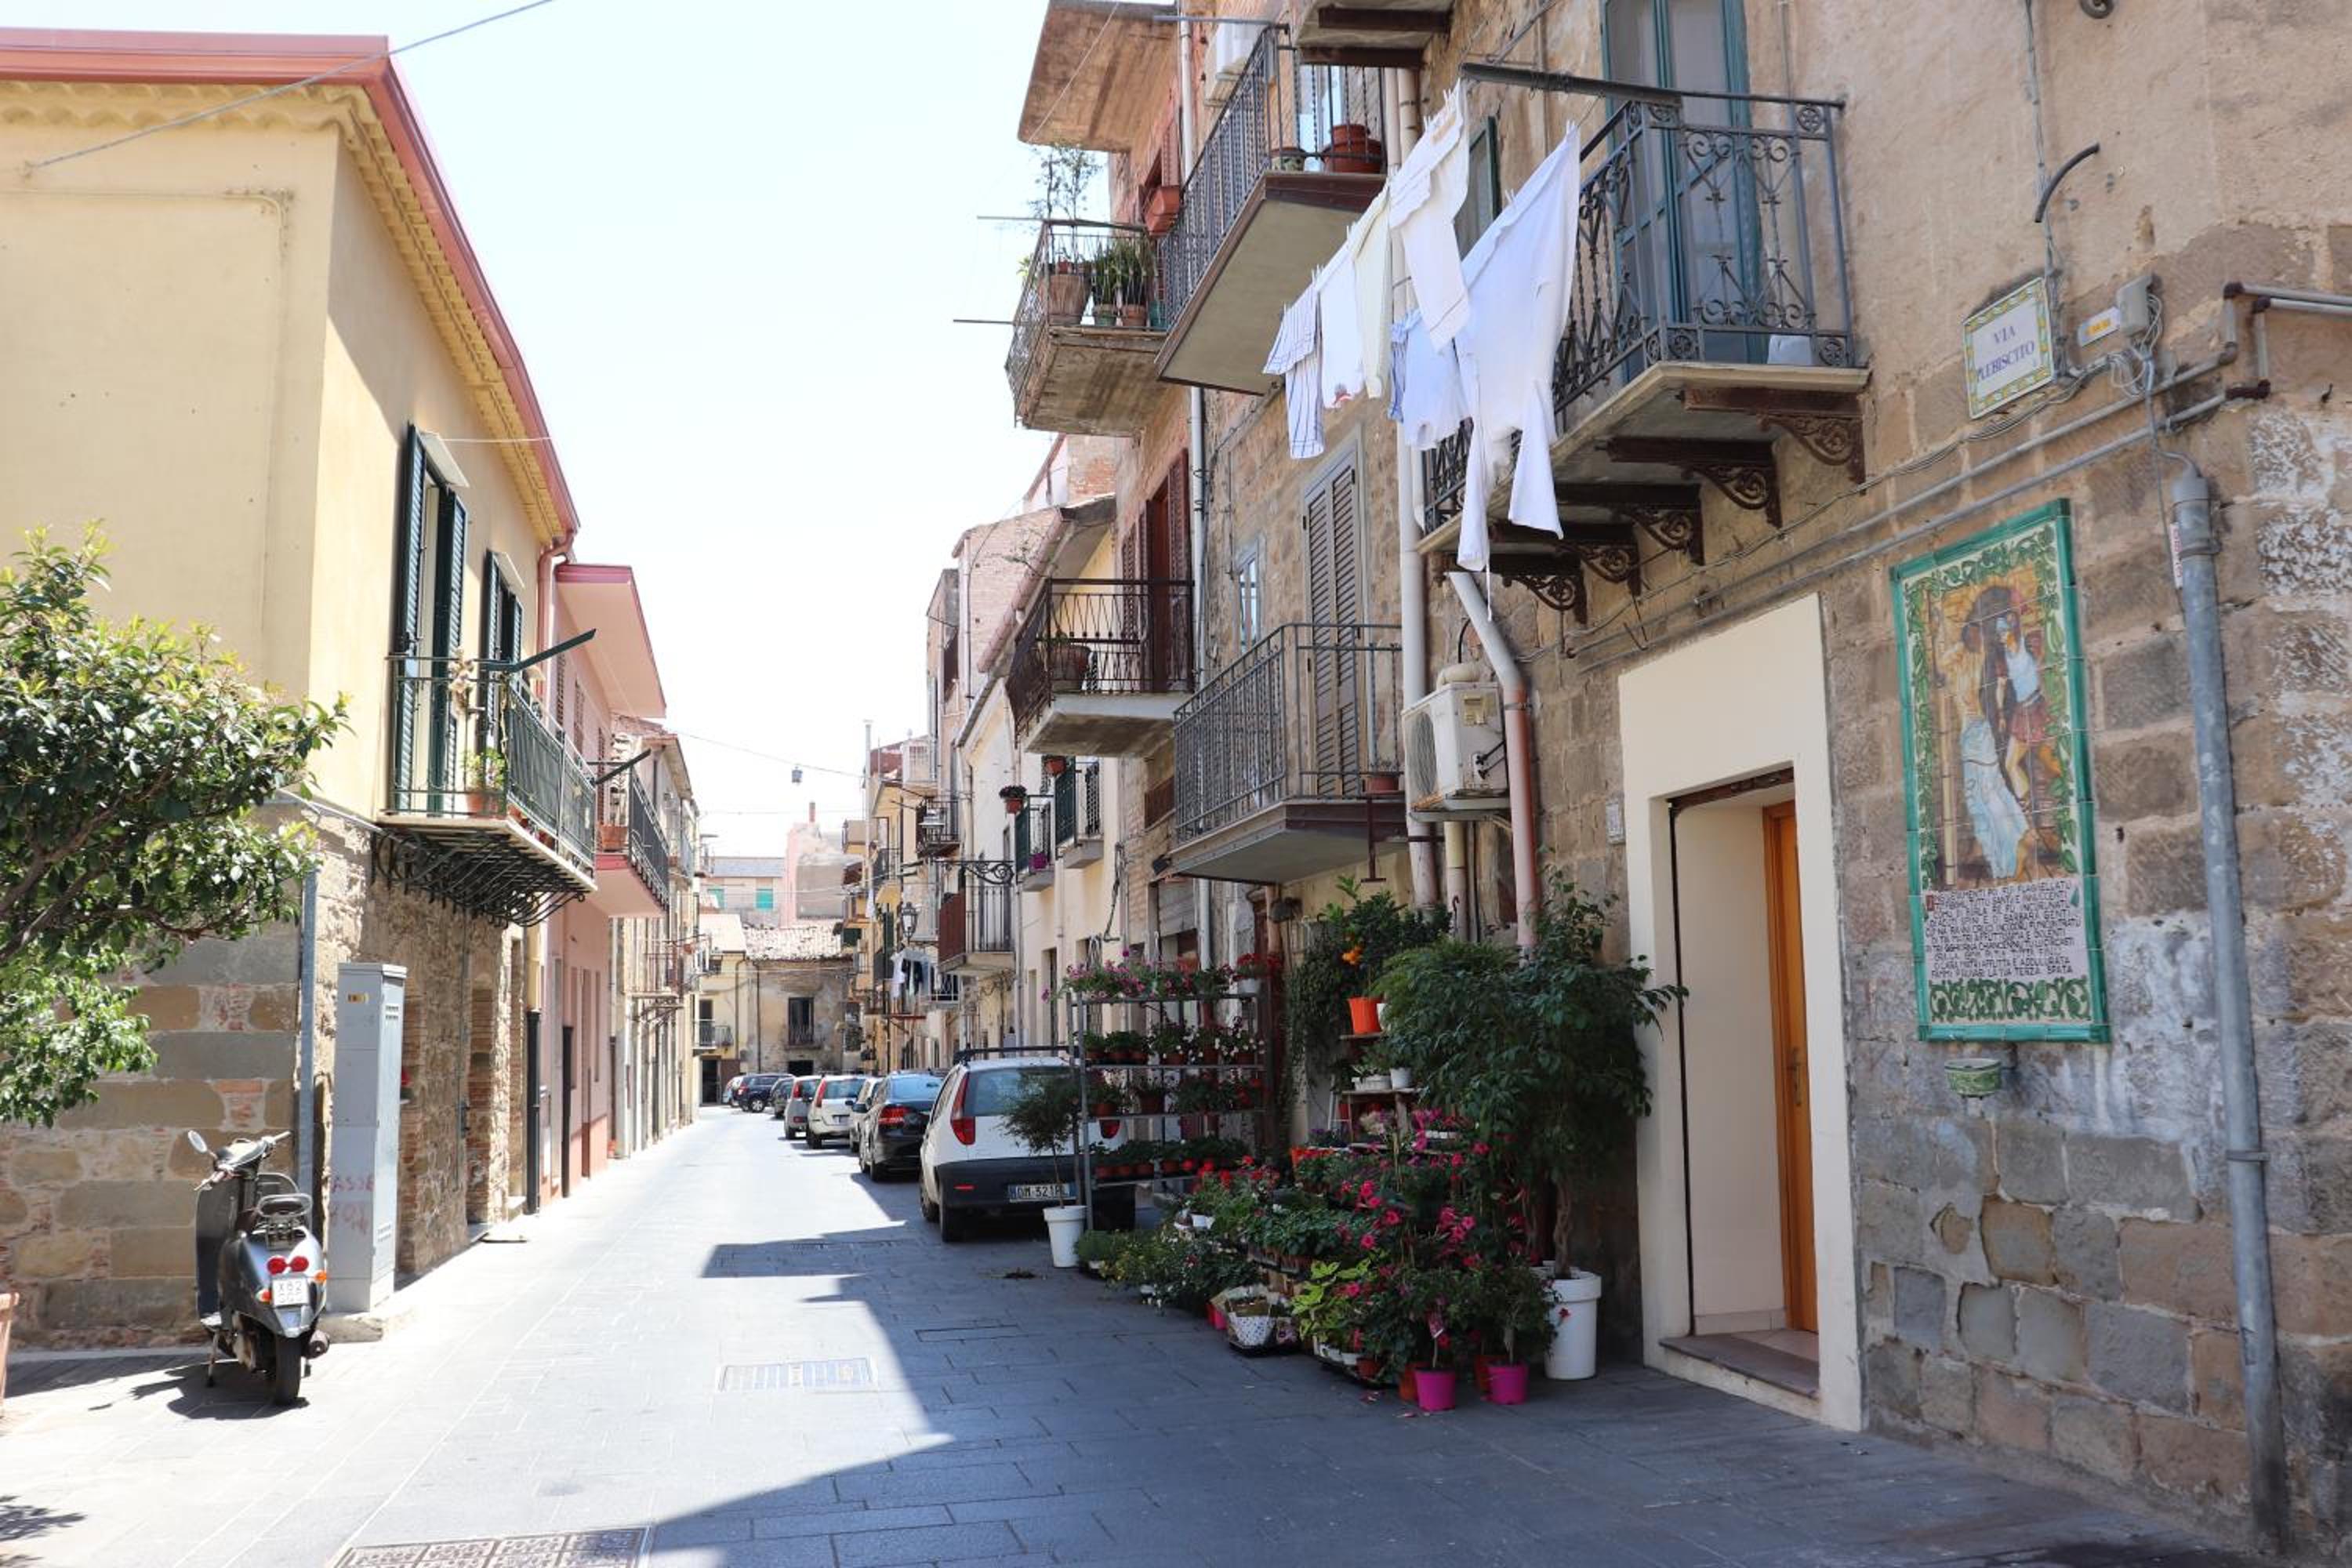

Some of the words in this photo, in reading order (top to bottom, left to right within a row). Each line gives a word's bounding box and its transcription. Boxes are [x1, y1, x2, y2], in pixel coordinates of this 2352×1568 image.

[1993, 325, 2016, 343] VIA
[1977, 341, 2035, 383] PLEBISCITO
[2047, 964, 2072, 974] SPATA
